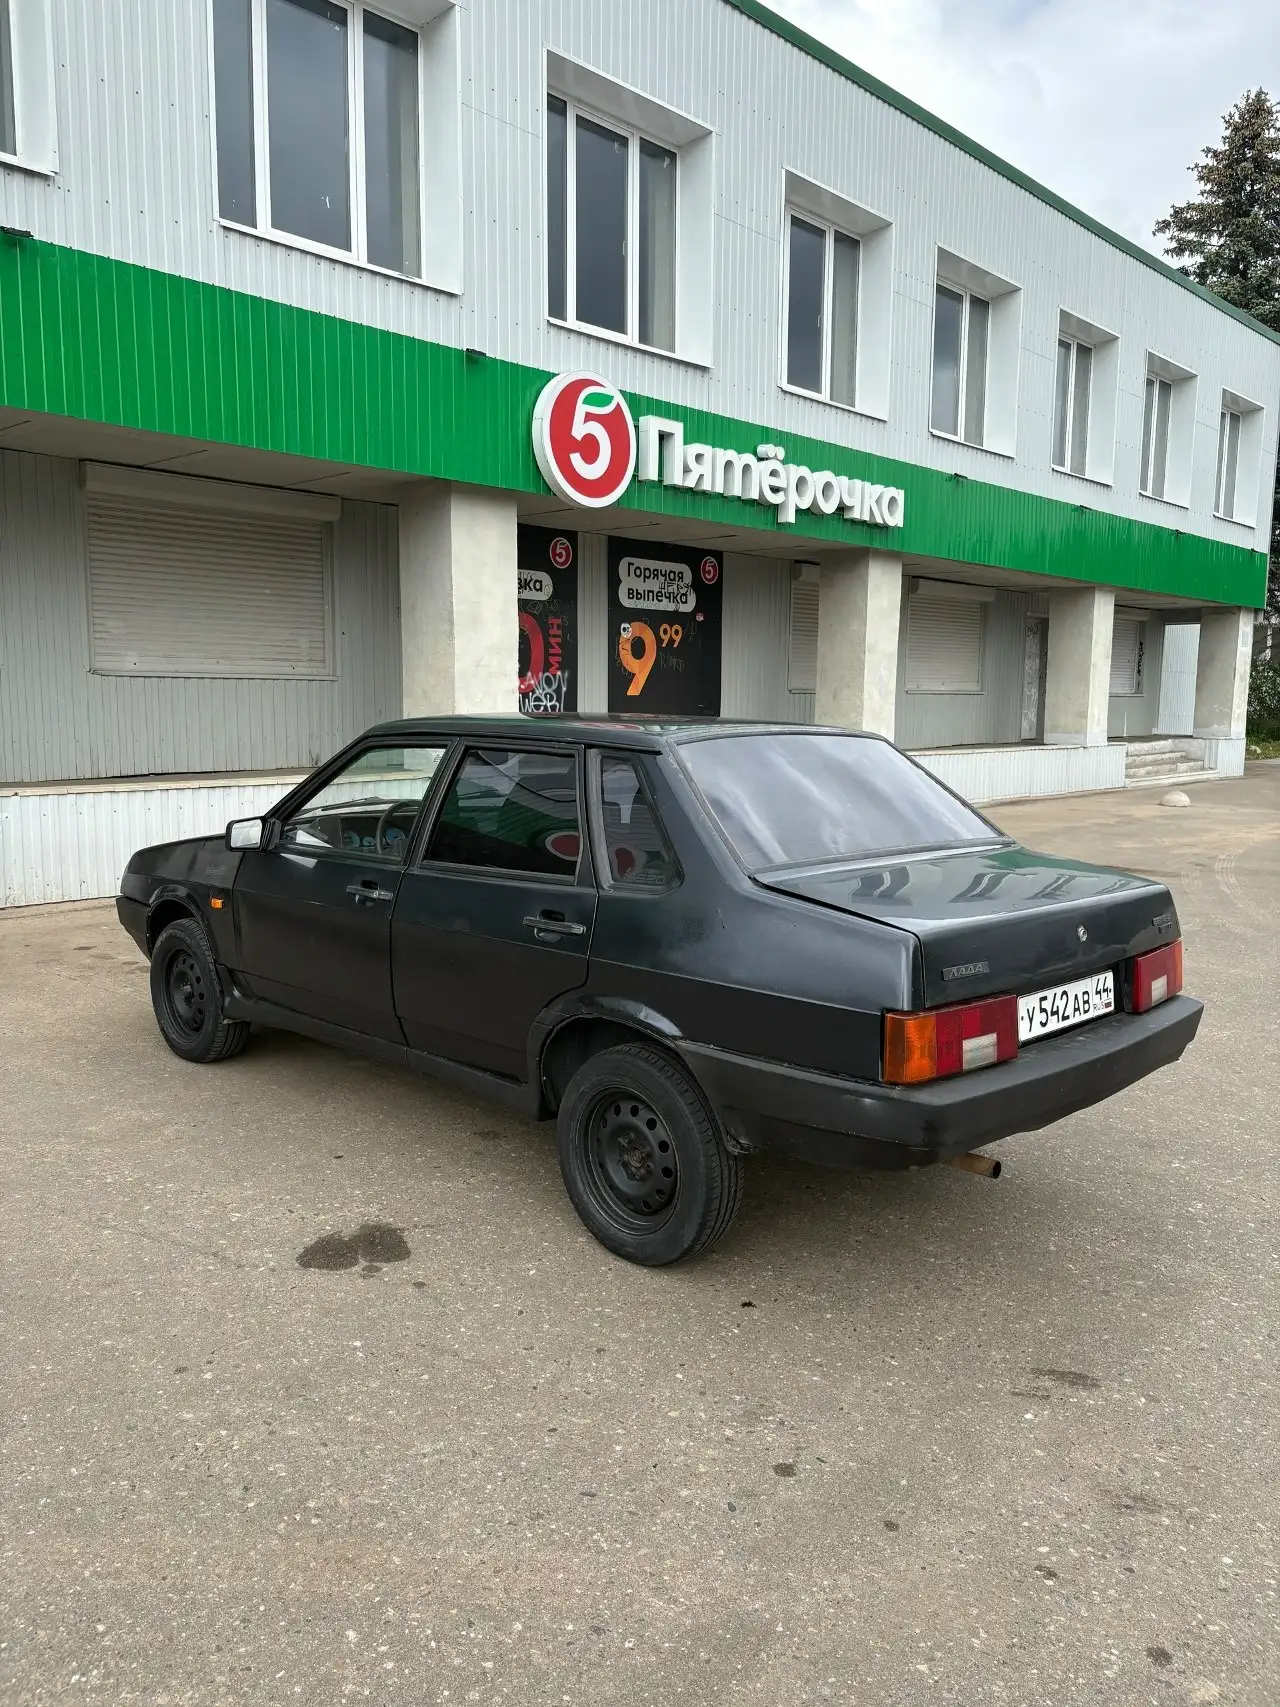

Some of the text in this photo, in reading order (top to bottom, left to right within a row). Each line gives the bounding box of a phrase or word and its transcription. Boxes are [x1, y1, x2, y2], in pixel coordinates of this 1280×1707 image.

[569, 385, 619, 480] 5
[638, 414, 905, 528] Пятёрочка
[627, 561, 684, 584] Горячая
[627, 587, 689, 605] выпечка
[618, 621, 658, 696] 9
[659, 623, 683, 648] 99
[1095, 975, 1110, 1001] 44
